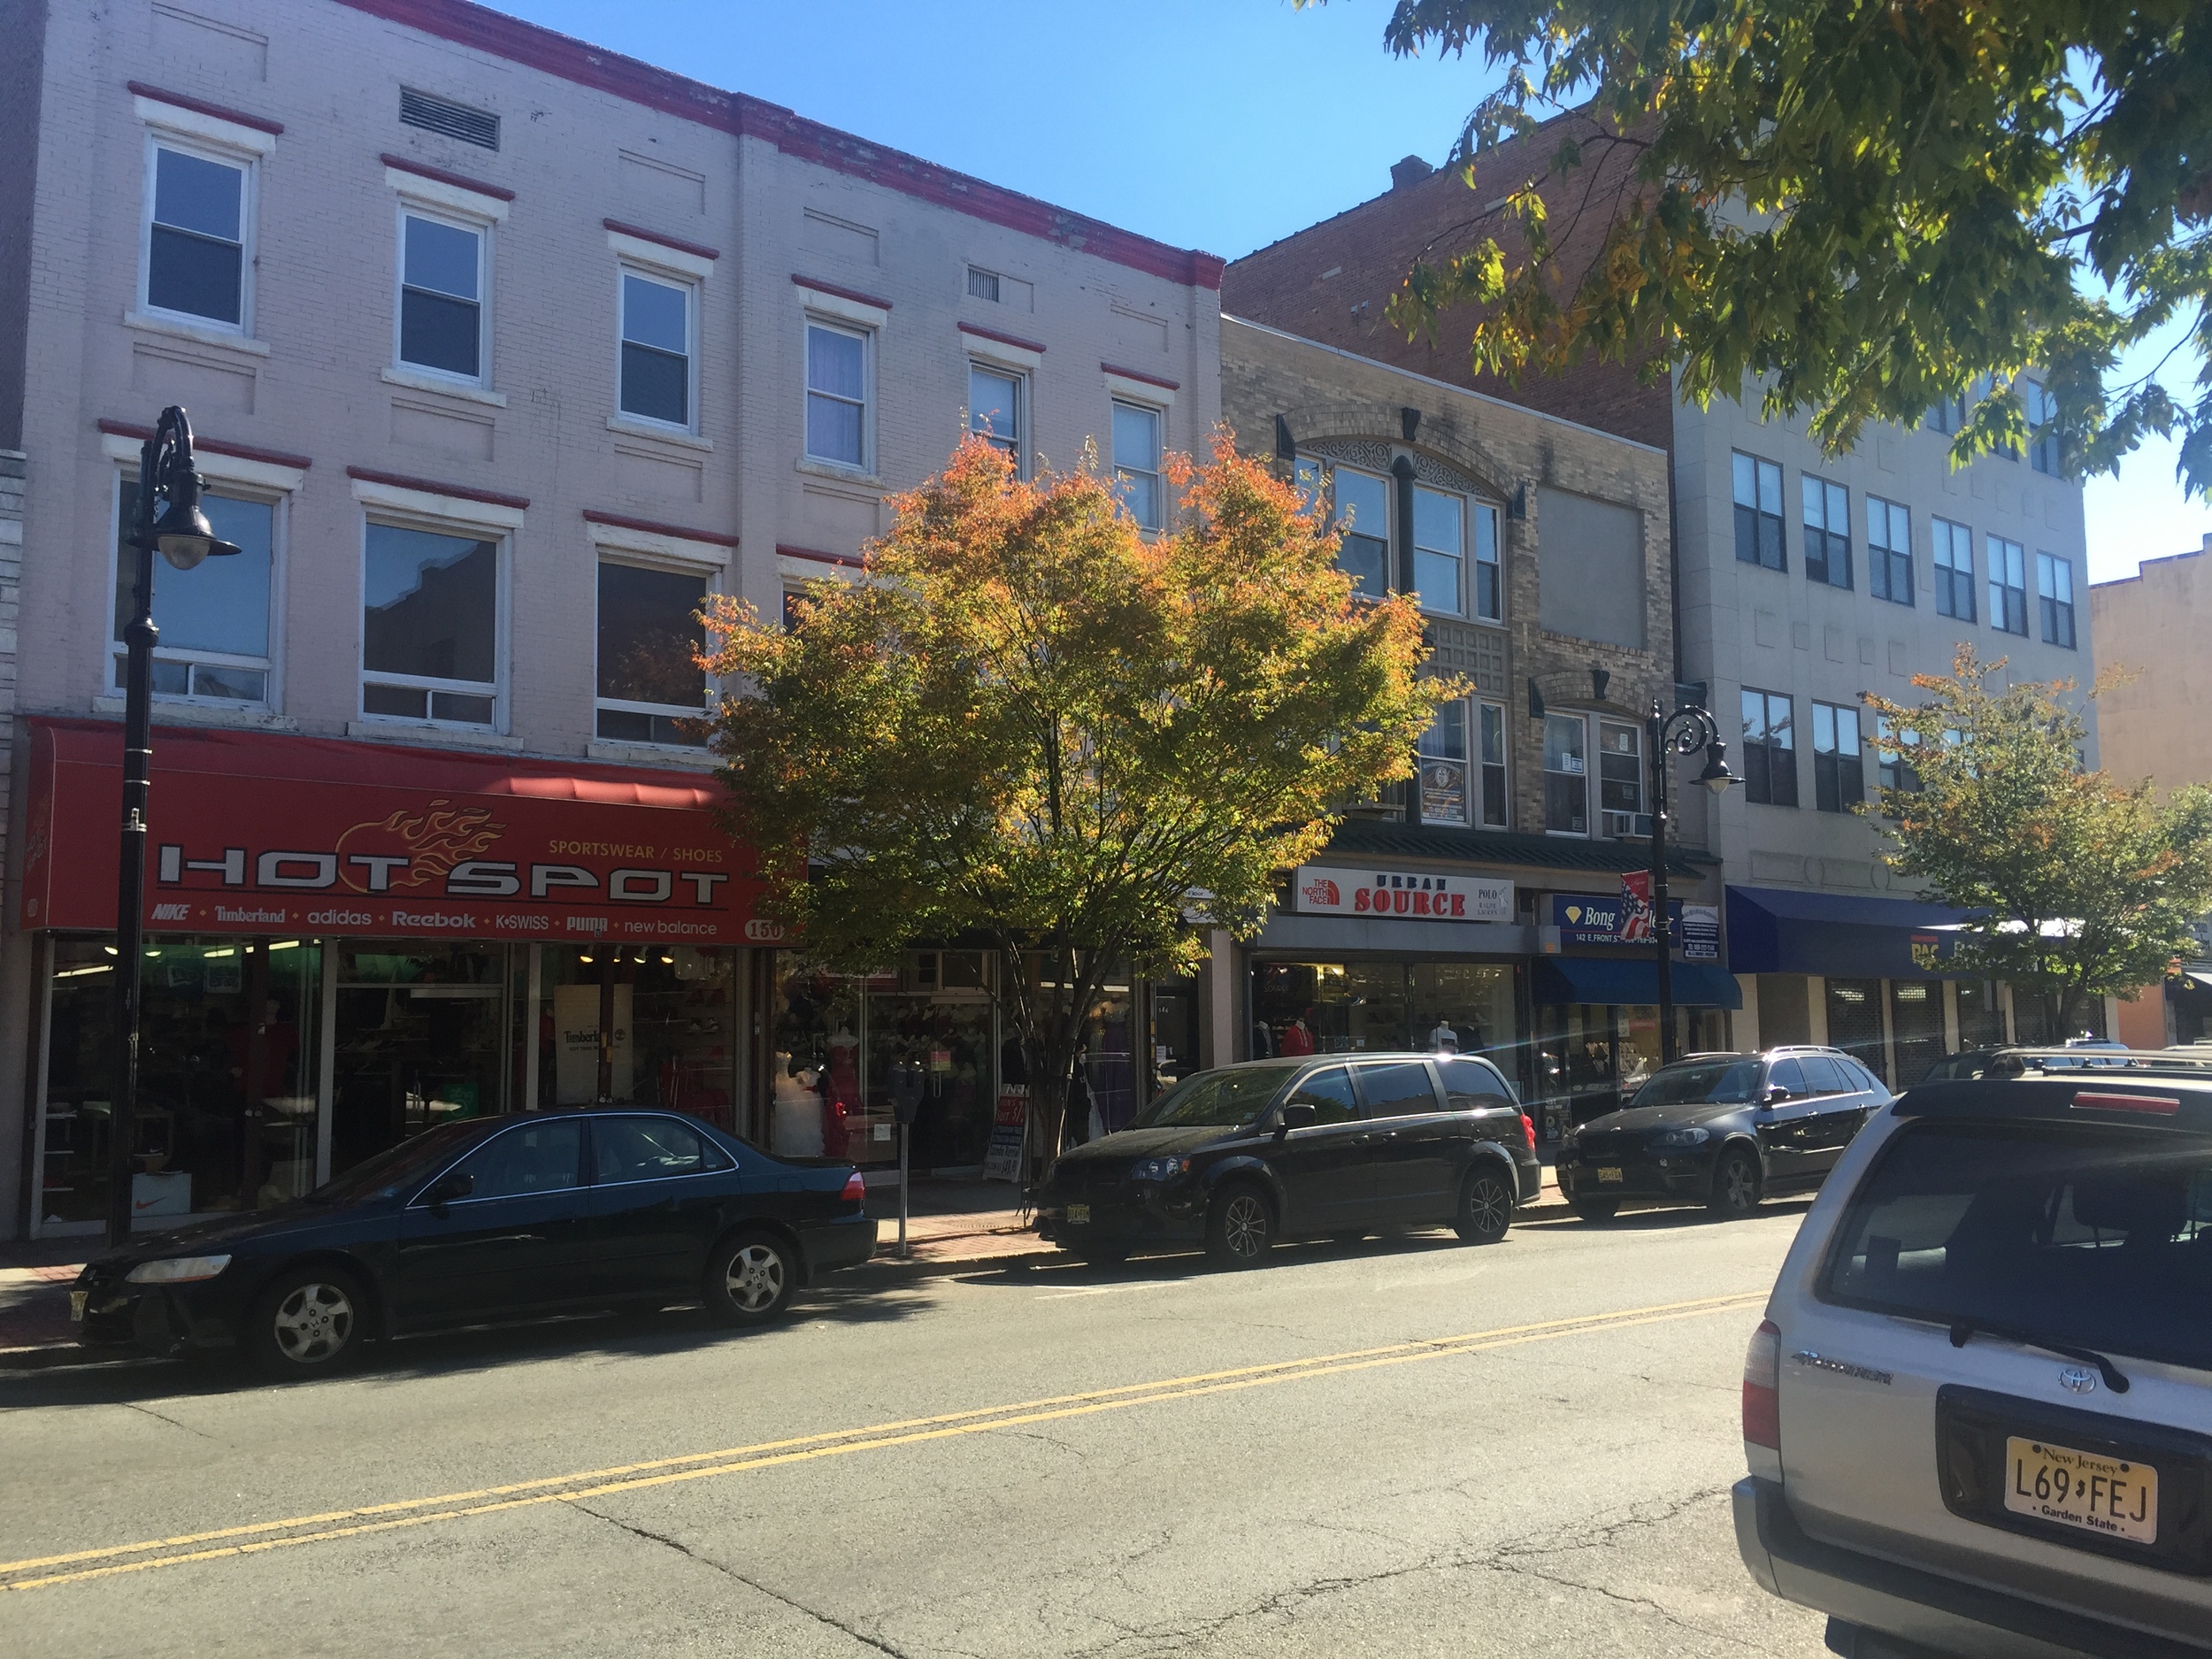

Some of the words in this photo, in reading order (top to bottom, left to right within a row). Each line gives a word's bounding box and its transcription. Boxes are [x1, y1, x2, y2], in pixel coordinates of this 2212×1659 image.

[549, 840, 654, 859] SPORTSWEAR
[673, 848, 722, 863] SHOES
[159, 844, 411, 893] HOT
[447, 859, 729, 906] SPOT
[1314, 879, 1327, 887] THE
[1377, 874, 1447, 891] URBAN
[1302, 887, 1328, 895] NORTH
[1309, 895, 1328, 905] FACE
[1479, 888, 1497, 899] POLO
[1355, 888, 1465, 917] SOURCE
[151, 903, 191, 921] NIKE
[214, 905, 286, 923] Timberland
[307, 910, 372, 926] adidas
[392, 910, 476, 928] Reebok
[1585, 906, 1615, 931] Bong
[566, 917, 608, 933] PUMA
[625, 920, 658, 933] new
[657, 920, 717, 935] balance
[749, 920, 784, 941] 150
[1576, 933, 1586, 942] 142
[2042, 1448, 2075, 1470] New
[2076, 1455, 2119, 1482] Jersey
[2016, 1459, 2070, 1504] L69
[2090, 1475, 2147, 1524] FEJ
[2041, 1505, 2083, 1525] Garden
[2085, 1516, 2119, 1532] State
